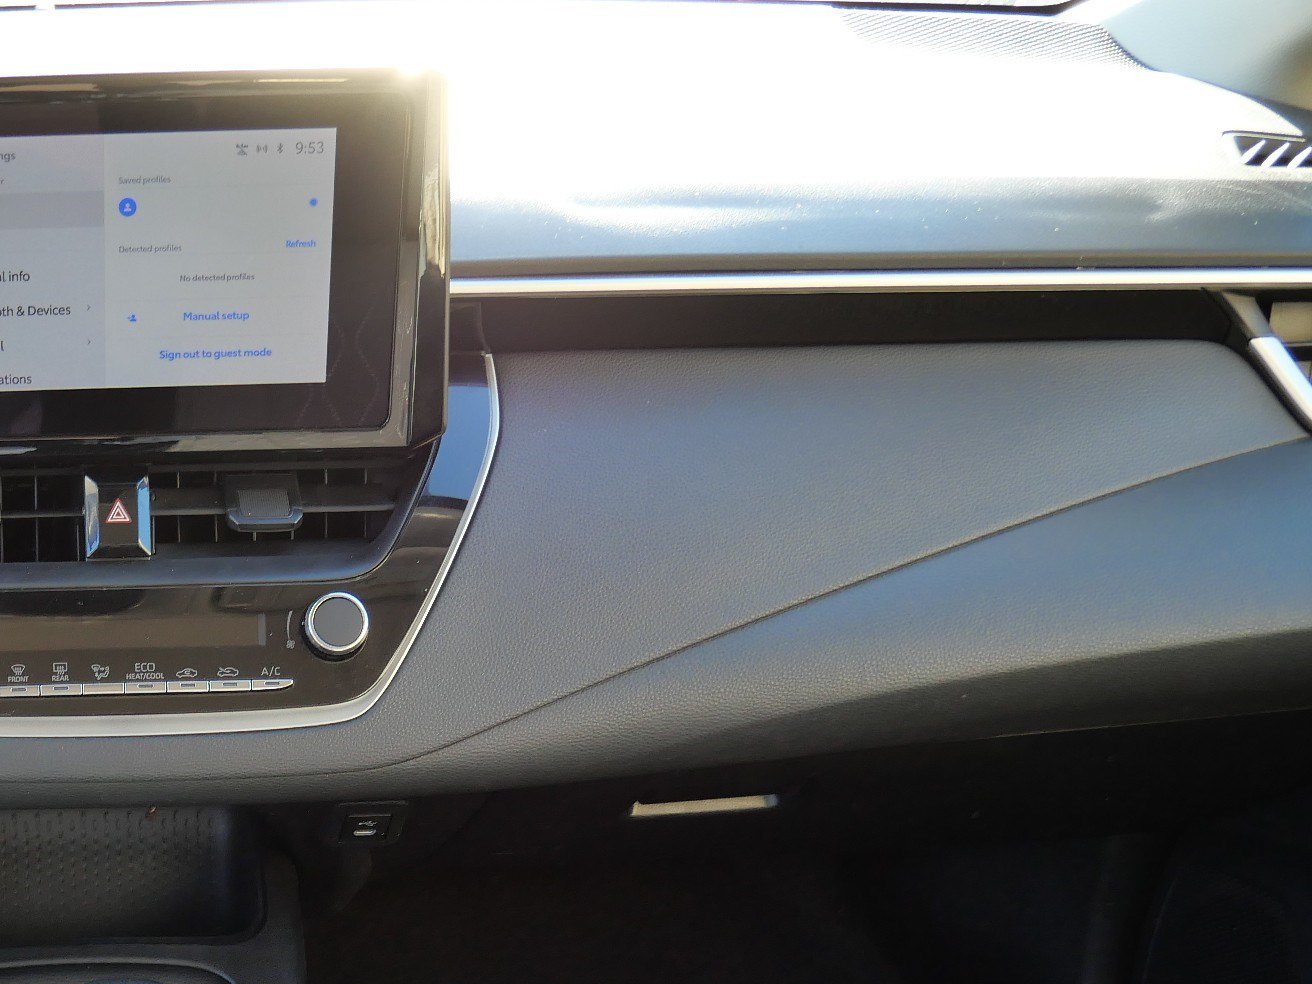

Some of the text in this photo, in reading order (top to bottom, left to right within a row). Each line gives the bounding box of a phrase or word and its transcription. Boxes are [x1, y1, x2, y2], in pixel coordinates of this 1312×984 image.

[295, 141, 325, 154] 9:53
[118, 175, 171, 186] Saved profiles
[118, 243, 182, 254] Detected profiles
[285, 239, 316, 249] Refresh
[8, 270, 30, 282] info
[179, 272, 255, 283] No detected profiles
[16, 306, 25, 317] &
[27, 304, 71, 316] Devices
[183, 311, 250, 322] Manual setup
[159, 348, 272, 361] Sign out to guest mode
[134, 662, 156, 672] ECO
[261, 665, 282, 677] A/C
[7, 675, 30, 683] FRONT
[51, 674, 70, 682] REAR
[126, 672, 165, 680] HEAT/COOL
